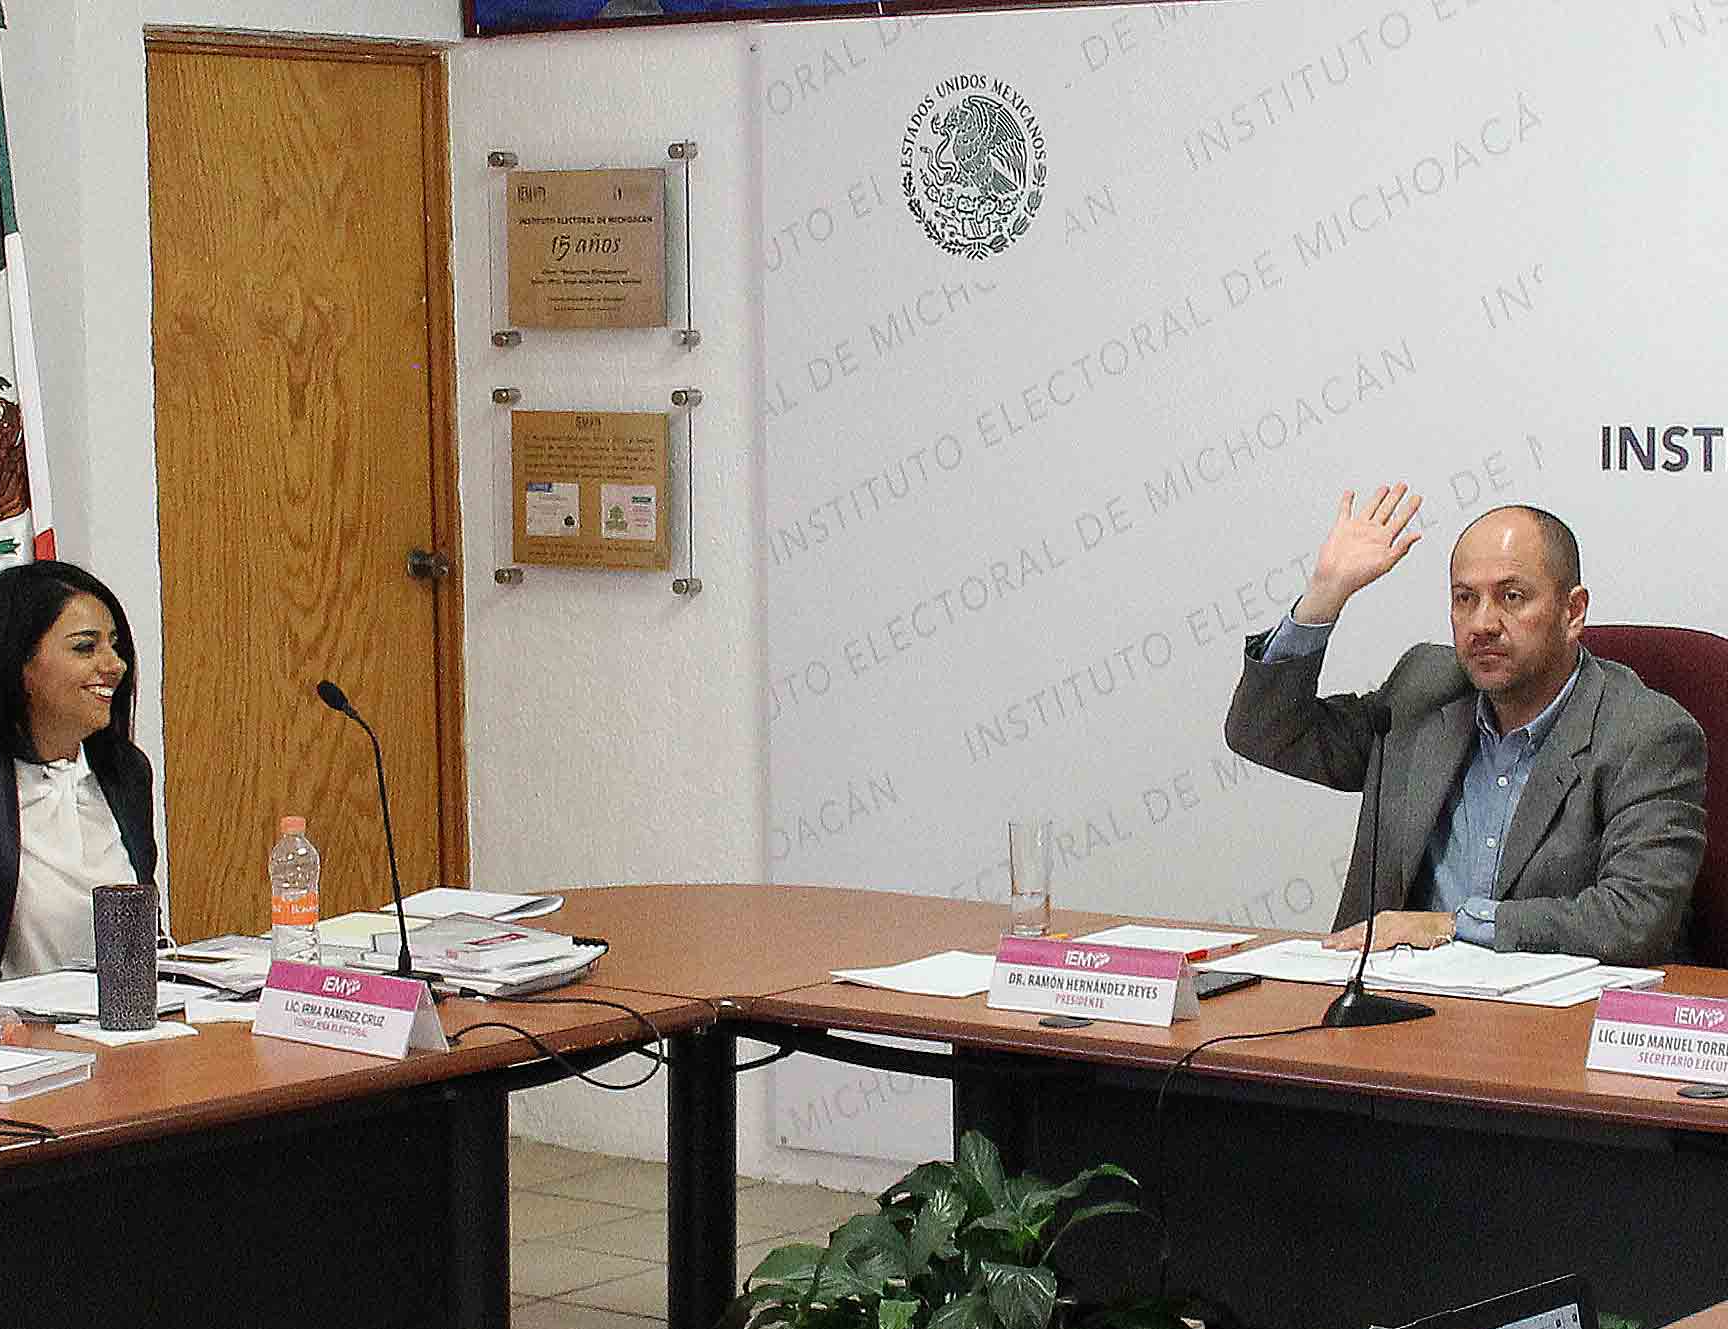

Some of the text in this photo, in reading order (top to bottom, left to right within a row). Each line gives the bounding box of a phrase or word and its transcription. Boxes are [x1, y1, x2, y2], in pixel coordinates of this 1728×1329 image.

[1183, 11, 1413, 172] INSTITUTO
[900, 74, 1047, 168] ESTADOS UNIDOS MEXICANOS
[575, 233, 621, 254] años
[768, 432, 964, 566] INSTITUTO
[975, 297, 1212, 449] ELECTORAL
[1220, 250, 1284, 309] DE
[843, 538, 1068, 680] ELECTORAL
[1073, 496, 1136, 553] DE
[1143, 338, 1417, 514] MICHOACÁN
[963, 630, 1172, 763] INSTITUTO
[1064, 950, 1093, 968] IEM
[1008, 971, 1159, 1000] DR. RAMÓN HERNÁNDEZ REYES
[301, 1002, 323, 1017] IRMA
[362, 1010, 385, 1027] CRUZ
[1674, 1006, 1705, 1026] IEM
[1598, 1029, 1618, 1044] LIC.
[1621, 1031, 1645, 1047] LUIS
[1646, 1034, 1694, 1053] MANUEL
[1637, 1051, 1694, 1069] SECRETARIO
